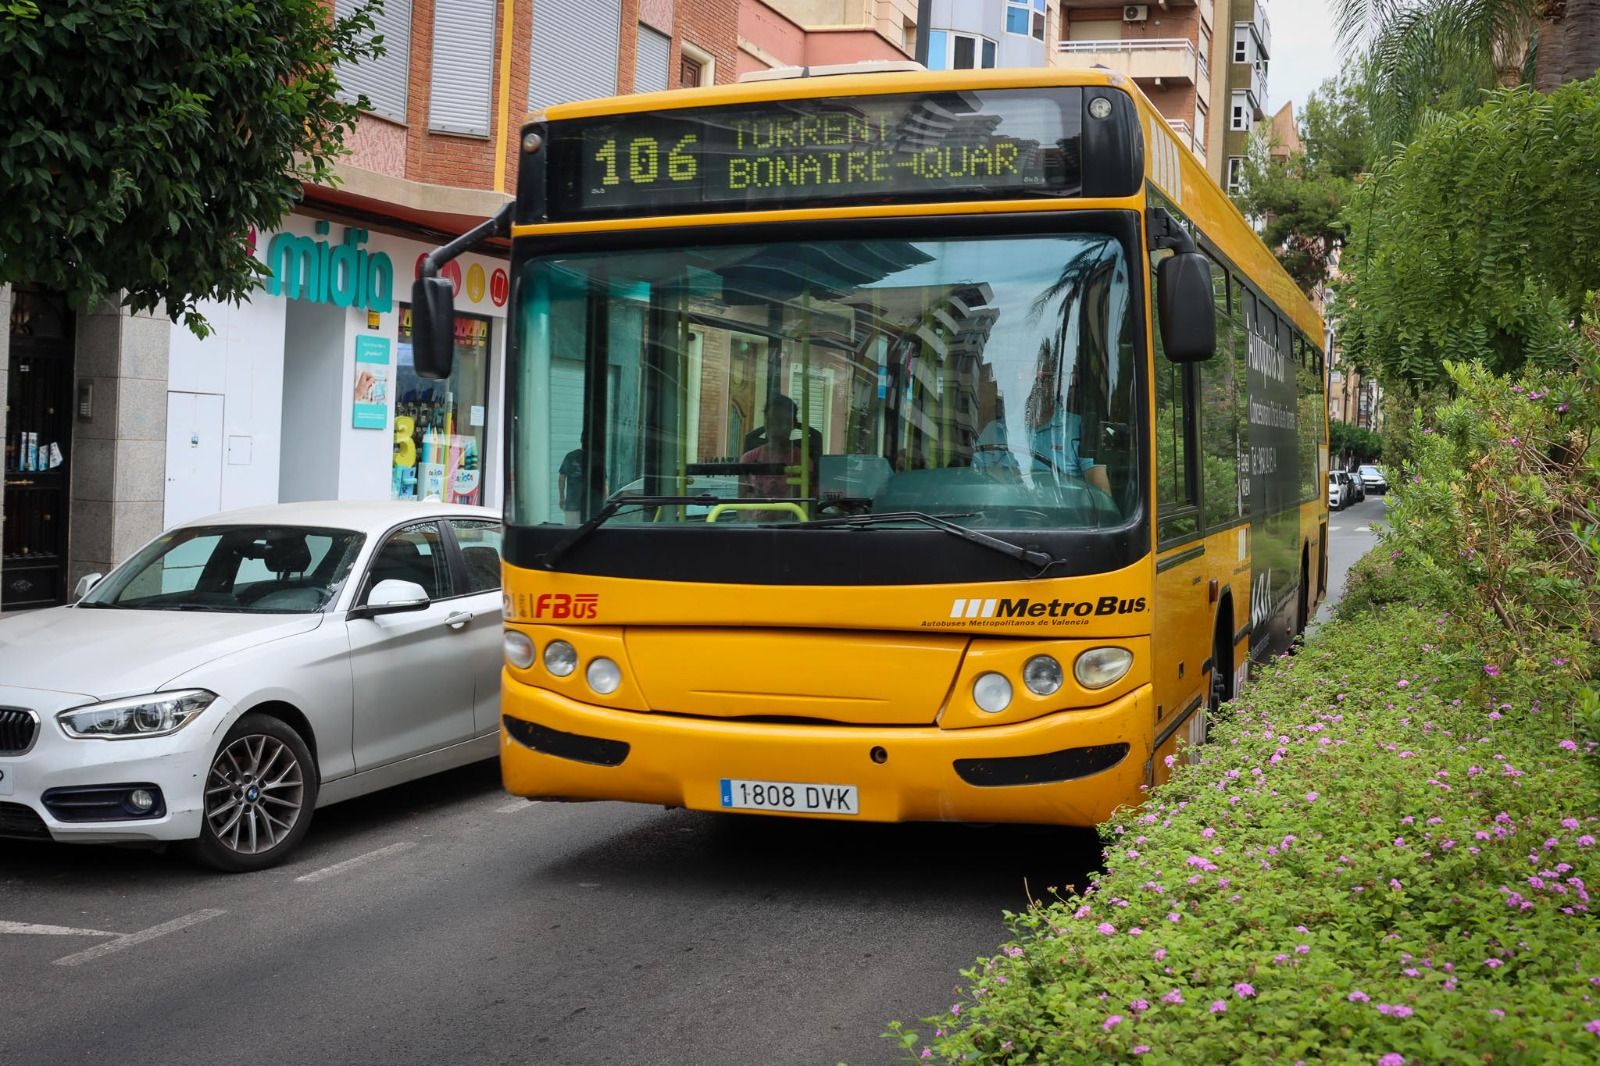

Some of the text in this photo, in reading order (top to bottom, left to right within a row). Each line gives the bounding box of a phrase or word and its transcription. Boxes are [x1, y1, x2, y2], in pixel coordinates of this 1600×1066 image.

[595, 134, 697, 185] 106
[266, 220, 393, 313] midia
[921, 619, 966, 627] Autobuses
[968, 619, 1035, 627] Metropolitanos
[1051, 618, 1090, 627] Valencia
[740, 783, 851, 810] 1808 DVK
